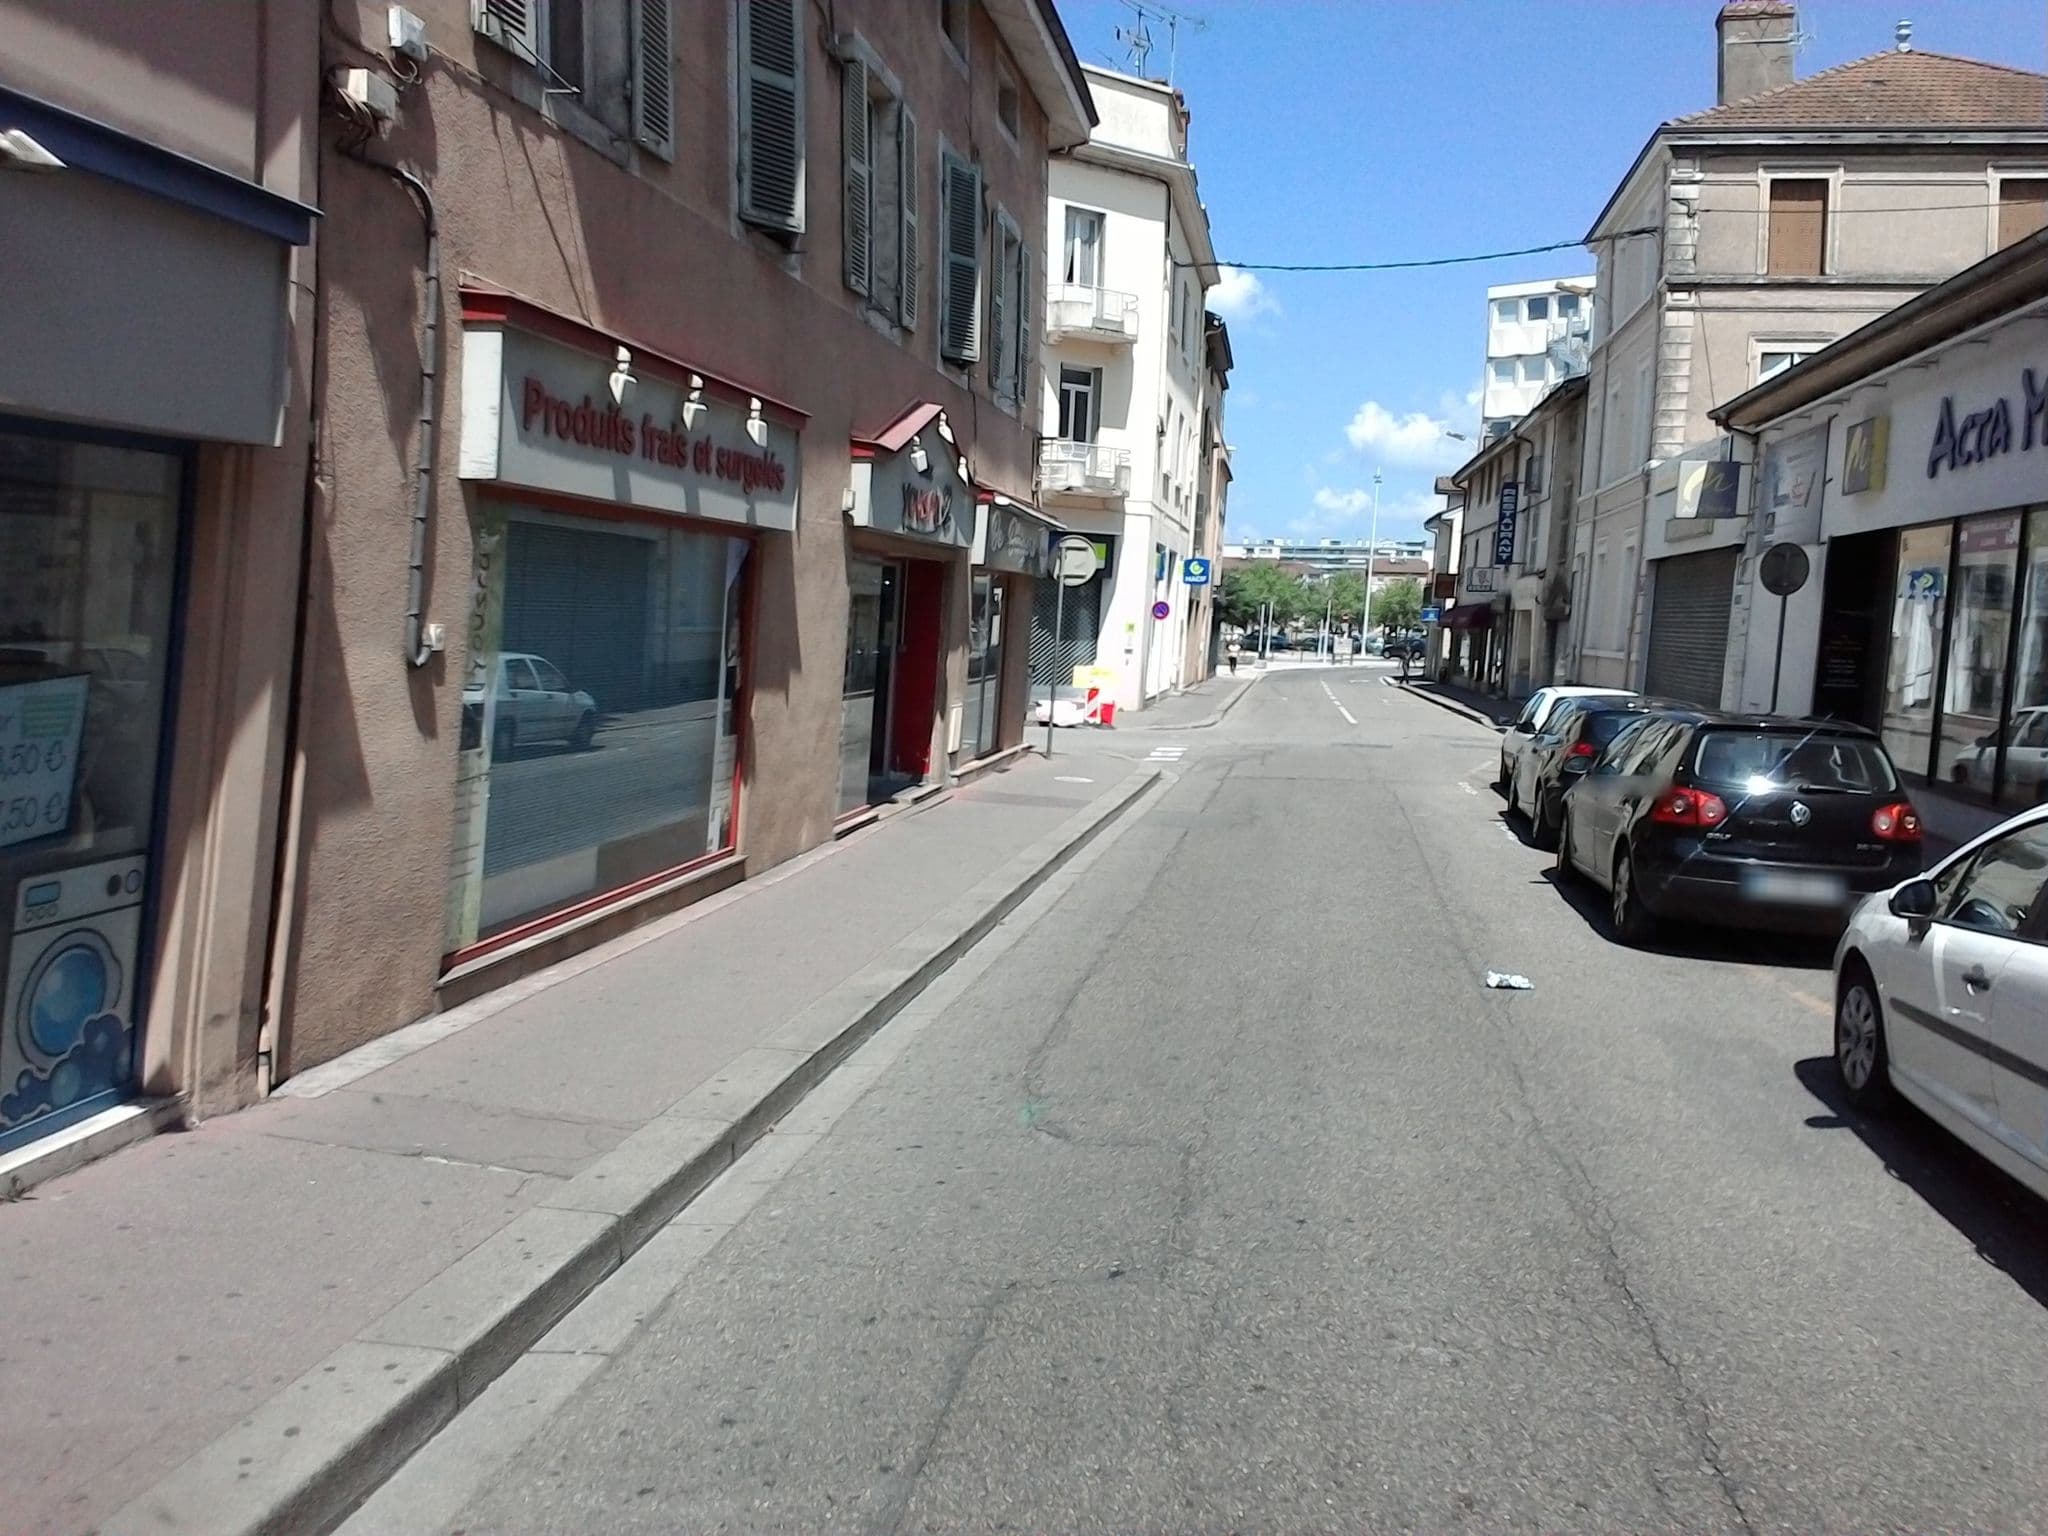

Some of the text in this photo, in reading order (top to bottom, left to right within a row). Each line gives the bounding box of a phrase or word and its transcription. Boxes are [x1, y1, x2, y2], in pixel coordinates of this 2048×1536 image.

[523, 375, 785, 494] Produits frais et surgelés
[1706, 832, 1732, 840] GOLF
